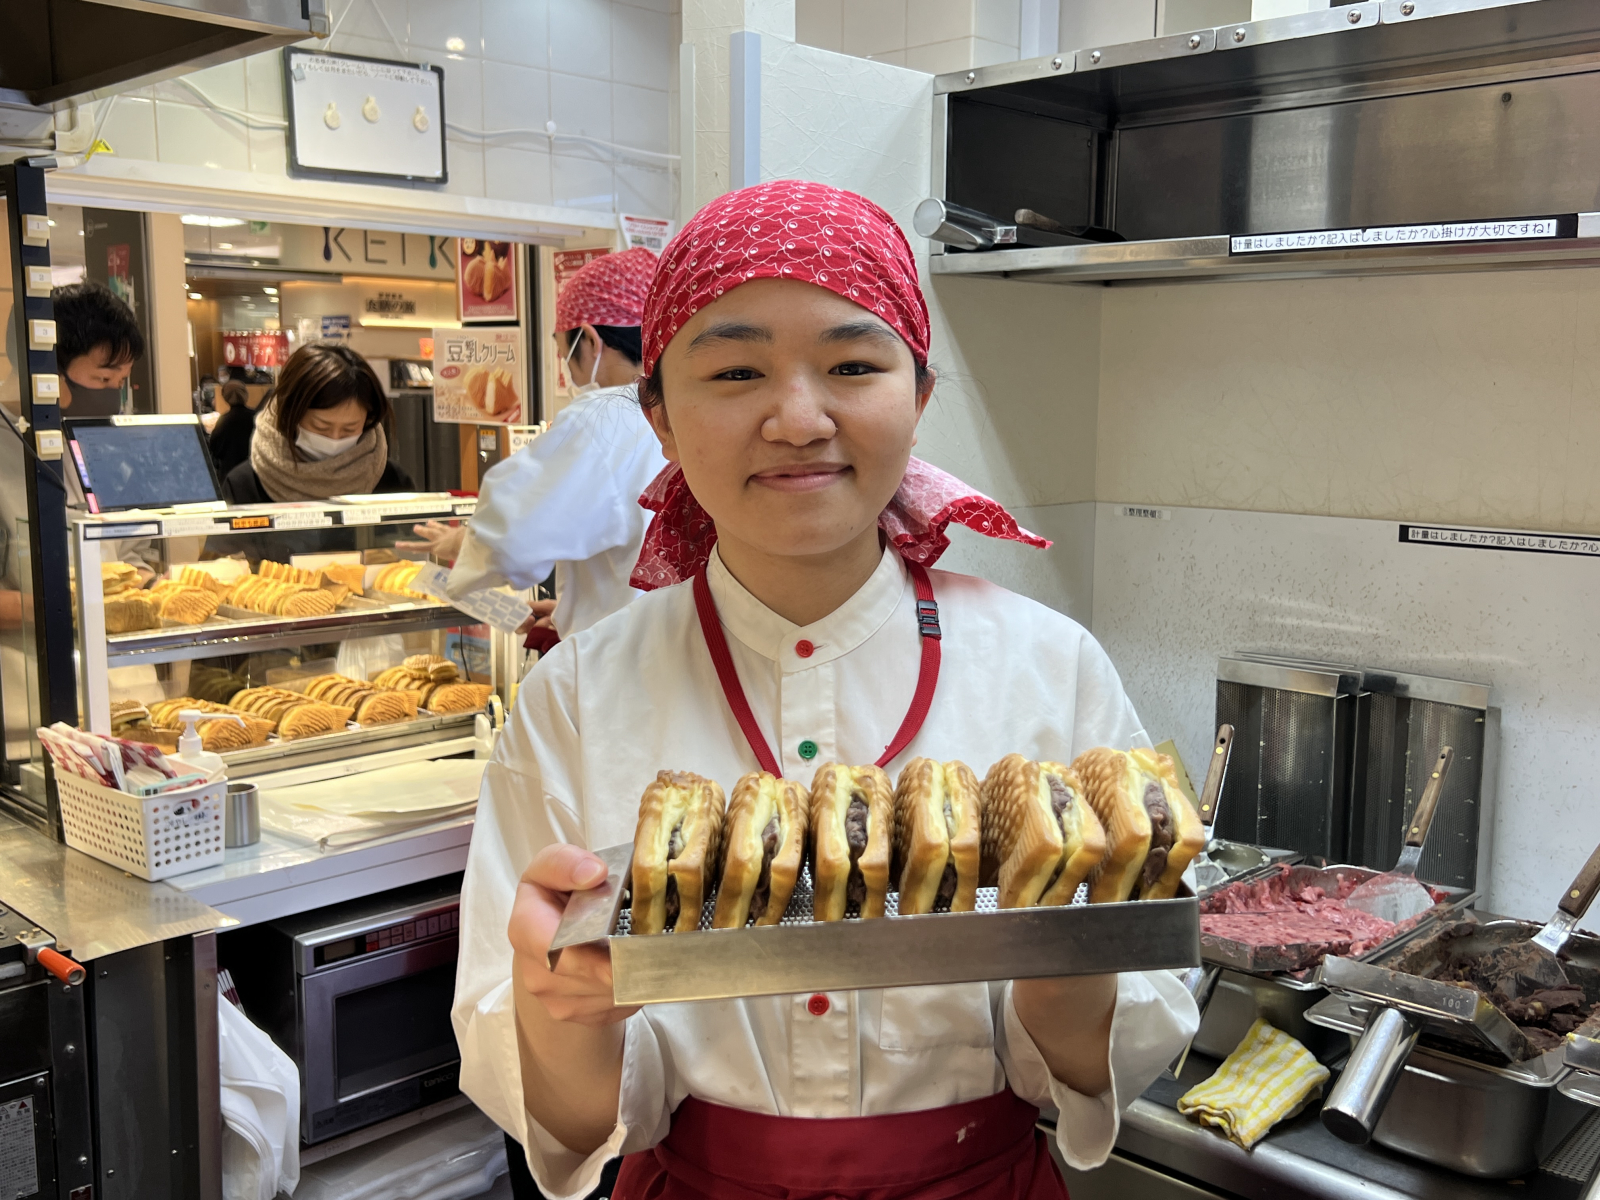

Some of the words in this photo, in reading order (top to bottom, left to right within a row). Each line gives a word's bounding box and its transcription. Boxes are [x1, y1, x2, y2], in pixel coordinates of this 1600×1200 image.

[446, 339, 516, 363] 豆乳クリーム
[1442, 997, 1461, 1010] 100
[423, 1072, 455, 1088] tanico
